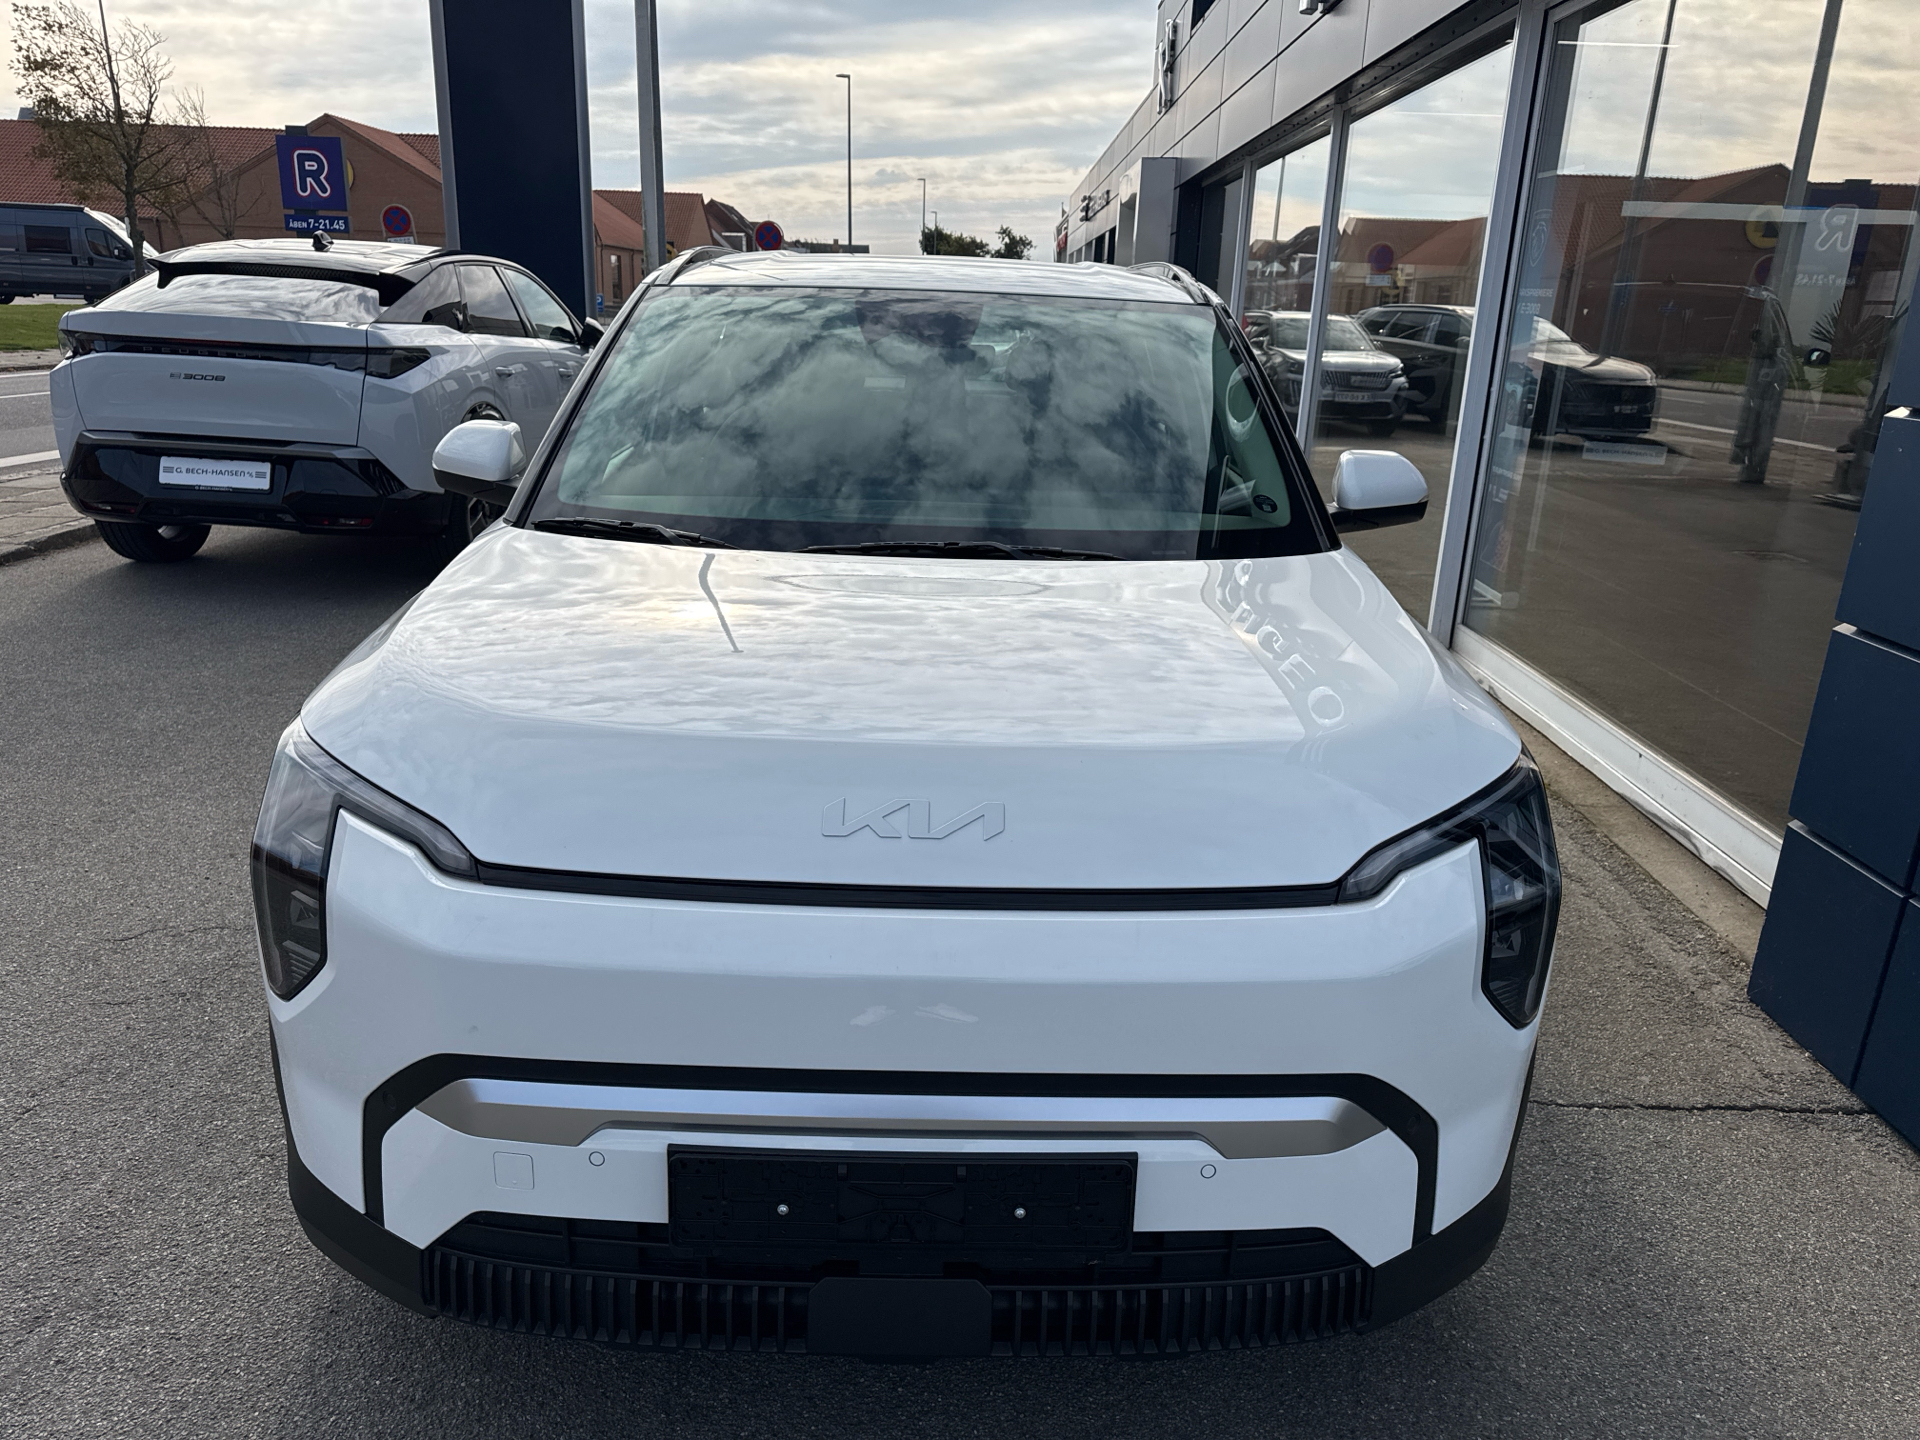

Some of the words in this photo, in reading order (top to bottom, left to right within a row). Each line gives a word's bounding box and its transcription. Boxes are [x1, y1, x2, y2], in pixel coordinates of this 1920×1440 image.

[293, 149, 331, 197] R
[289, 219, 307, 228] ÅBEN
[308, 219, 345, 230] 7-21.45
[185, 467, 246, 478] BECH-HANSEN
[822, 796, 1005, 842] KIA
